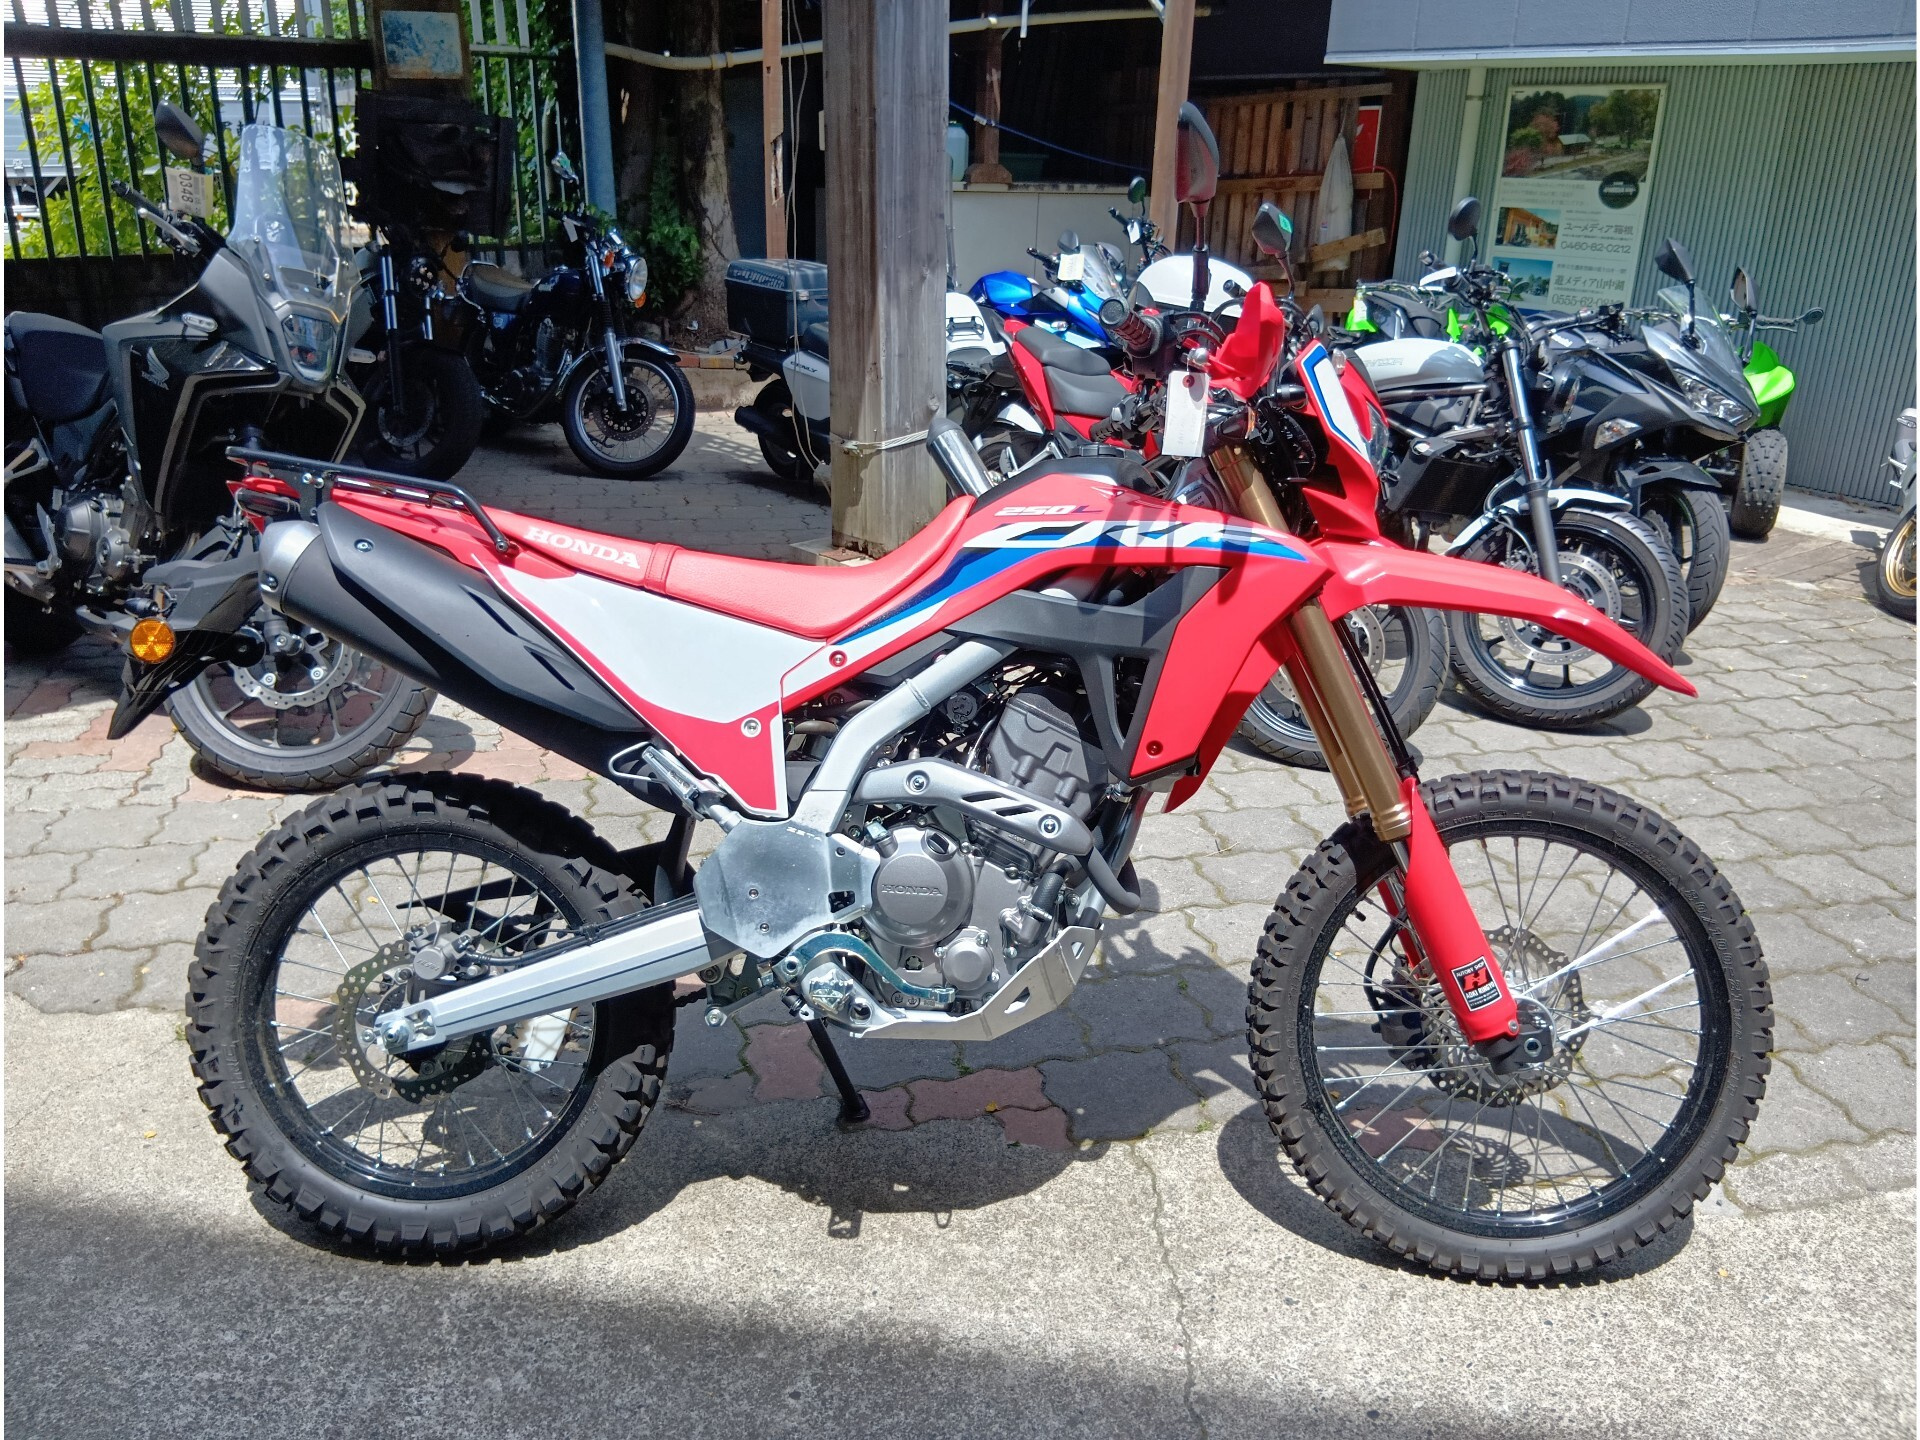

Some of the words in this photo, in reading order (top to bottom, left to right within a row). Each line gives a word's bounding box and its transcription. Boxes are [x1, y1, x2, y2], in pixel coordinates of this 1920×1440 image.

[179, 173, 194, 203] 0348
[1560, 241, 1632, 254] 0460-82-0212
[994, 504, 1103, 517] 250L
[523, 525, 641, 570] HONDA
[881, 883, 944, 897] HONDA
